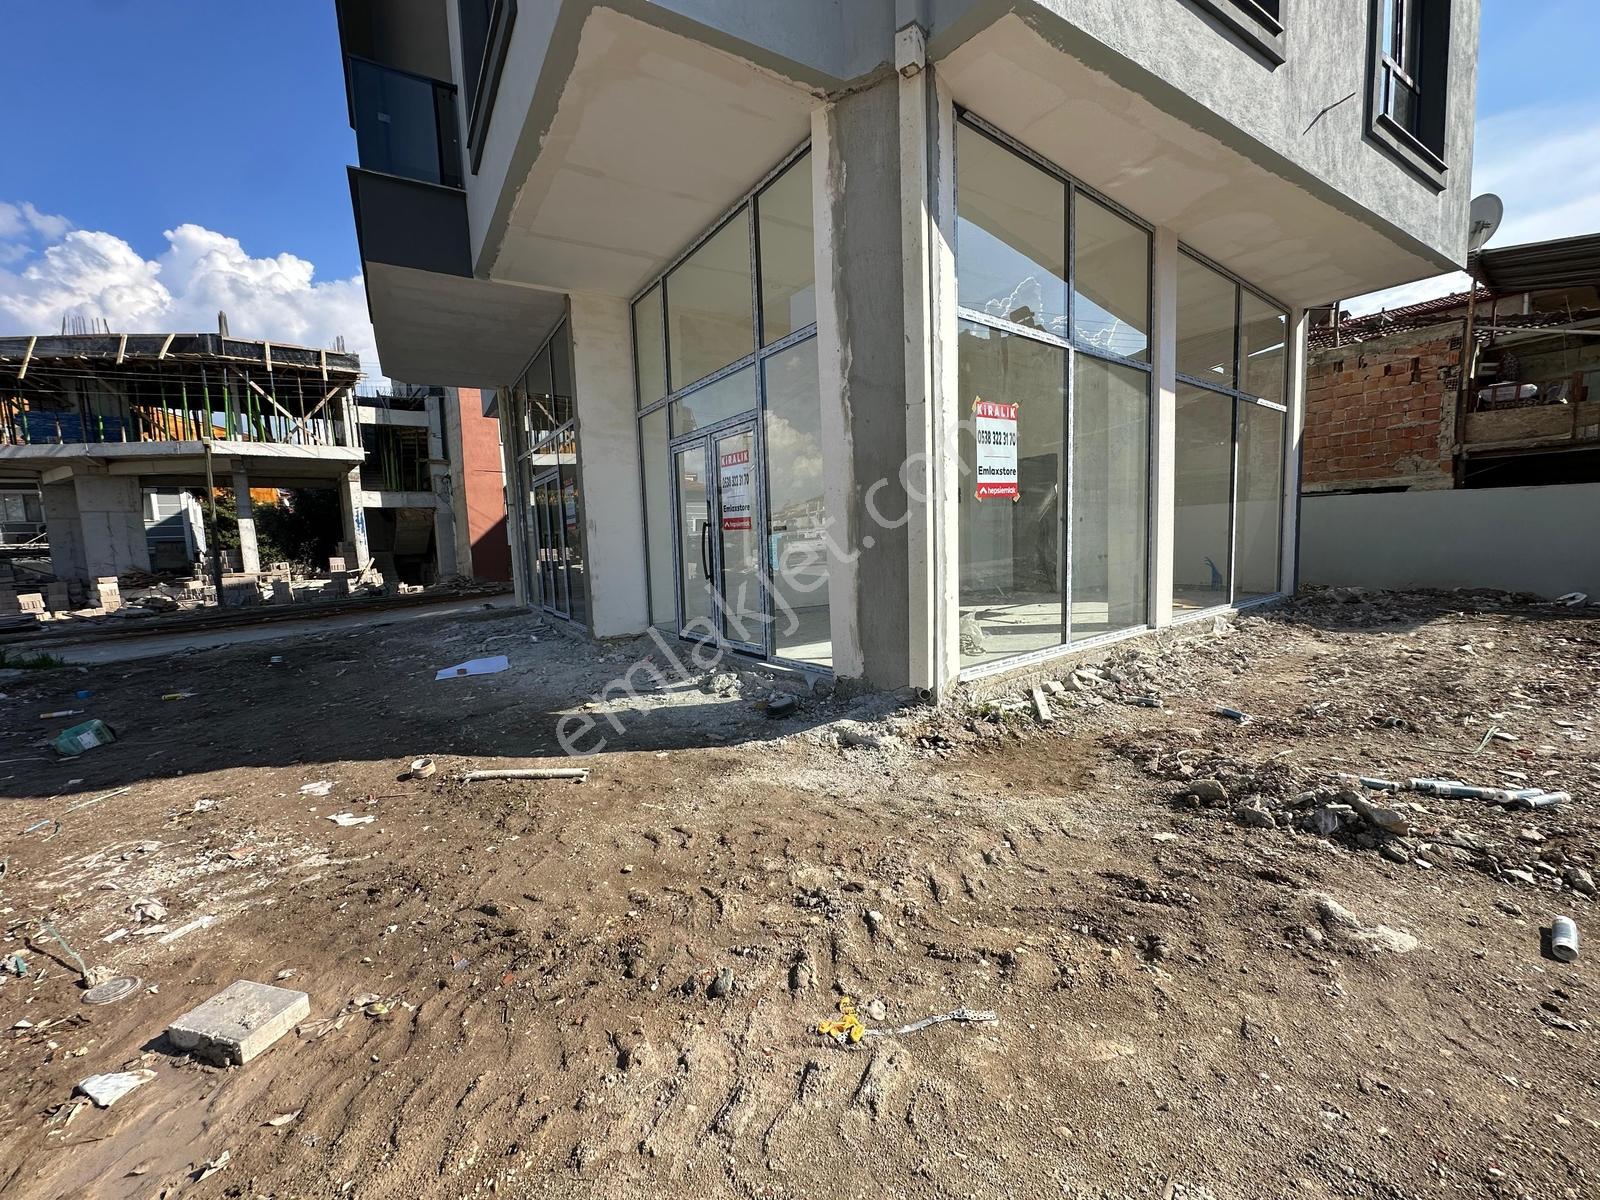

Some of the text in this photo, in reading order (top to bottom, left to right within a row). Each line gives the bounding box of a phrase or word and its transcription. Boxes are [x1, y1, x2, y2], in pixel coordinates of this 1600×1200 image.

[977, 429, 991, 444] 0538
[992, 431, 1002, 445] 322
[978, 465, 1017, 476] Emlaxstore
